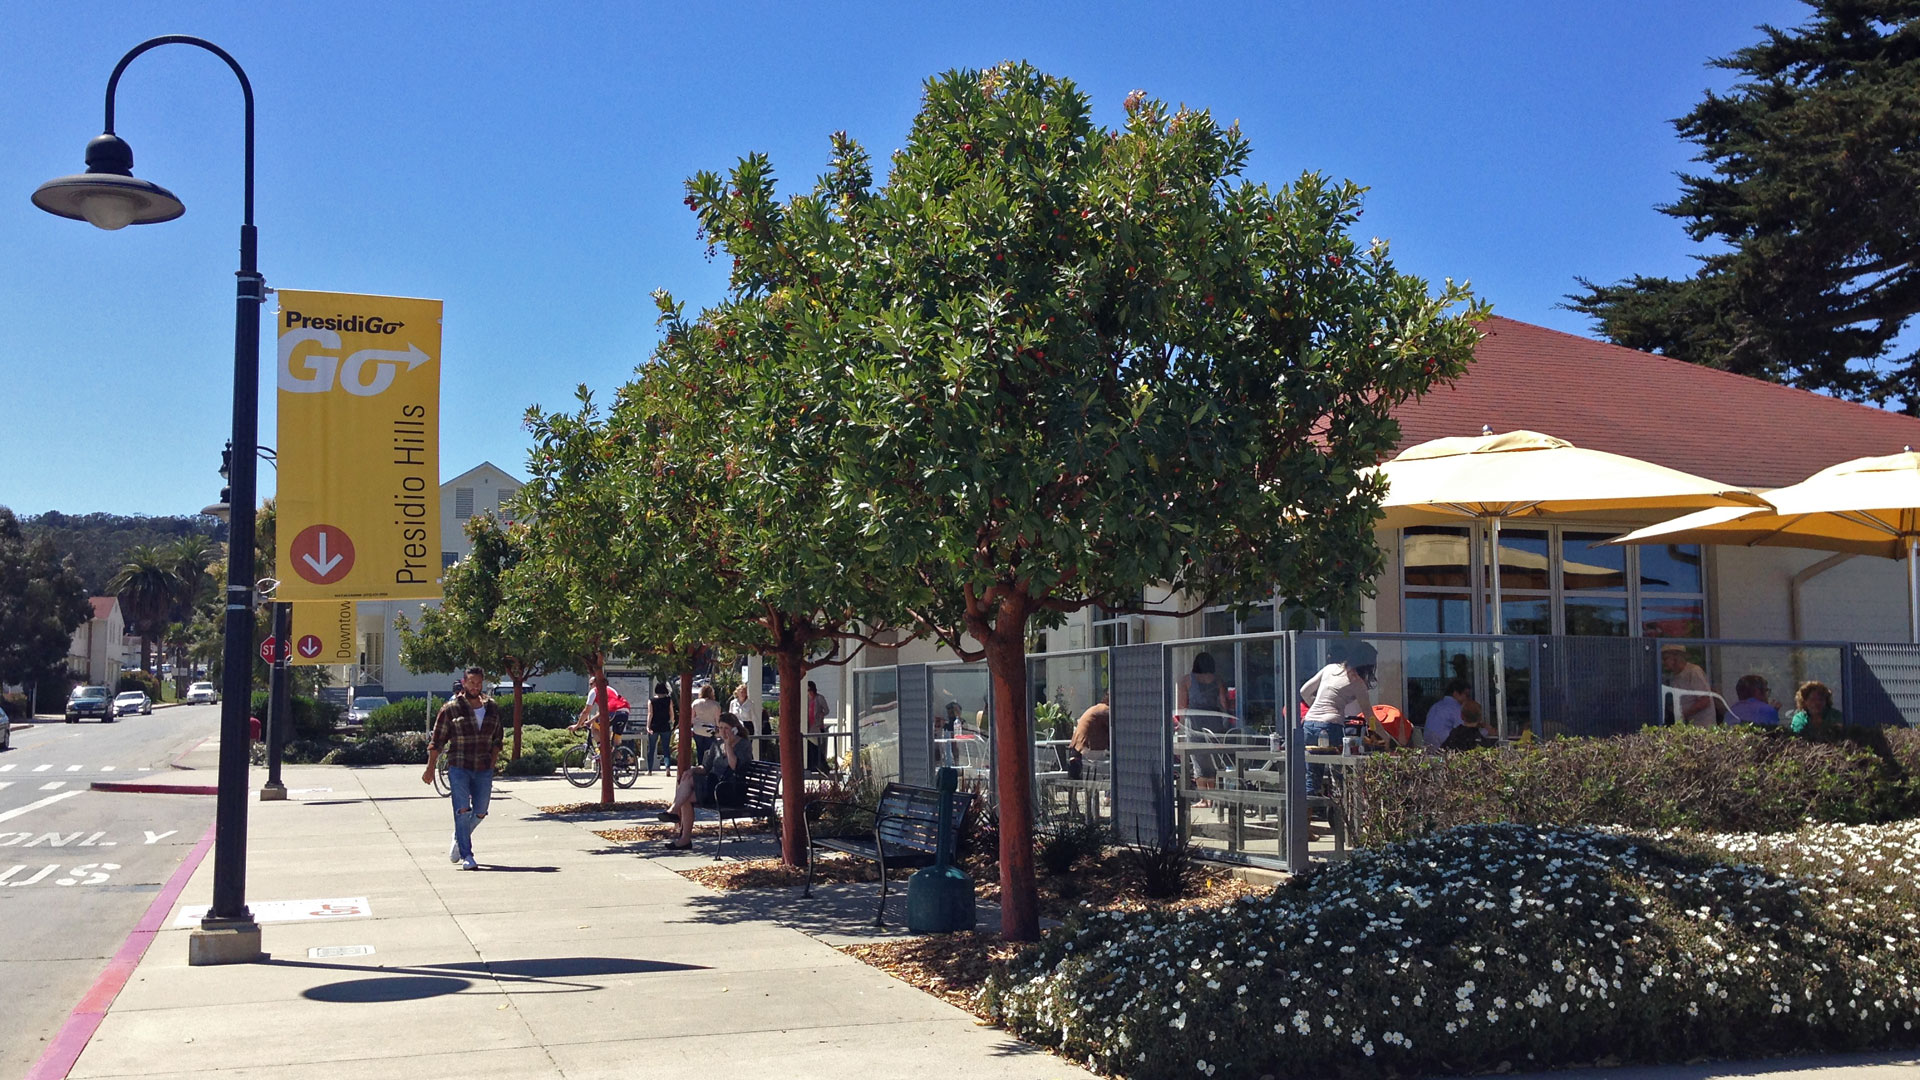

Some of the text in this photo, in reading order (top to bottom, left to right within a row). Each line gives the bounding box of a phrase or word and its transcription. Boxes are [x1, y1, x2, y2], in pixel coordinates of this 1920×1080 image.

[286, 311, 404, 334] PresidiGo
[278, 327, 431, 397] Go
[394, 405, 427, 583] Presidio Hills
[336, 601, 351, 658] Downtow
[0, 863, 122, 887] US
